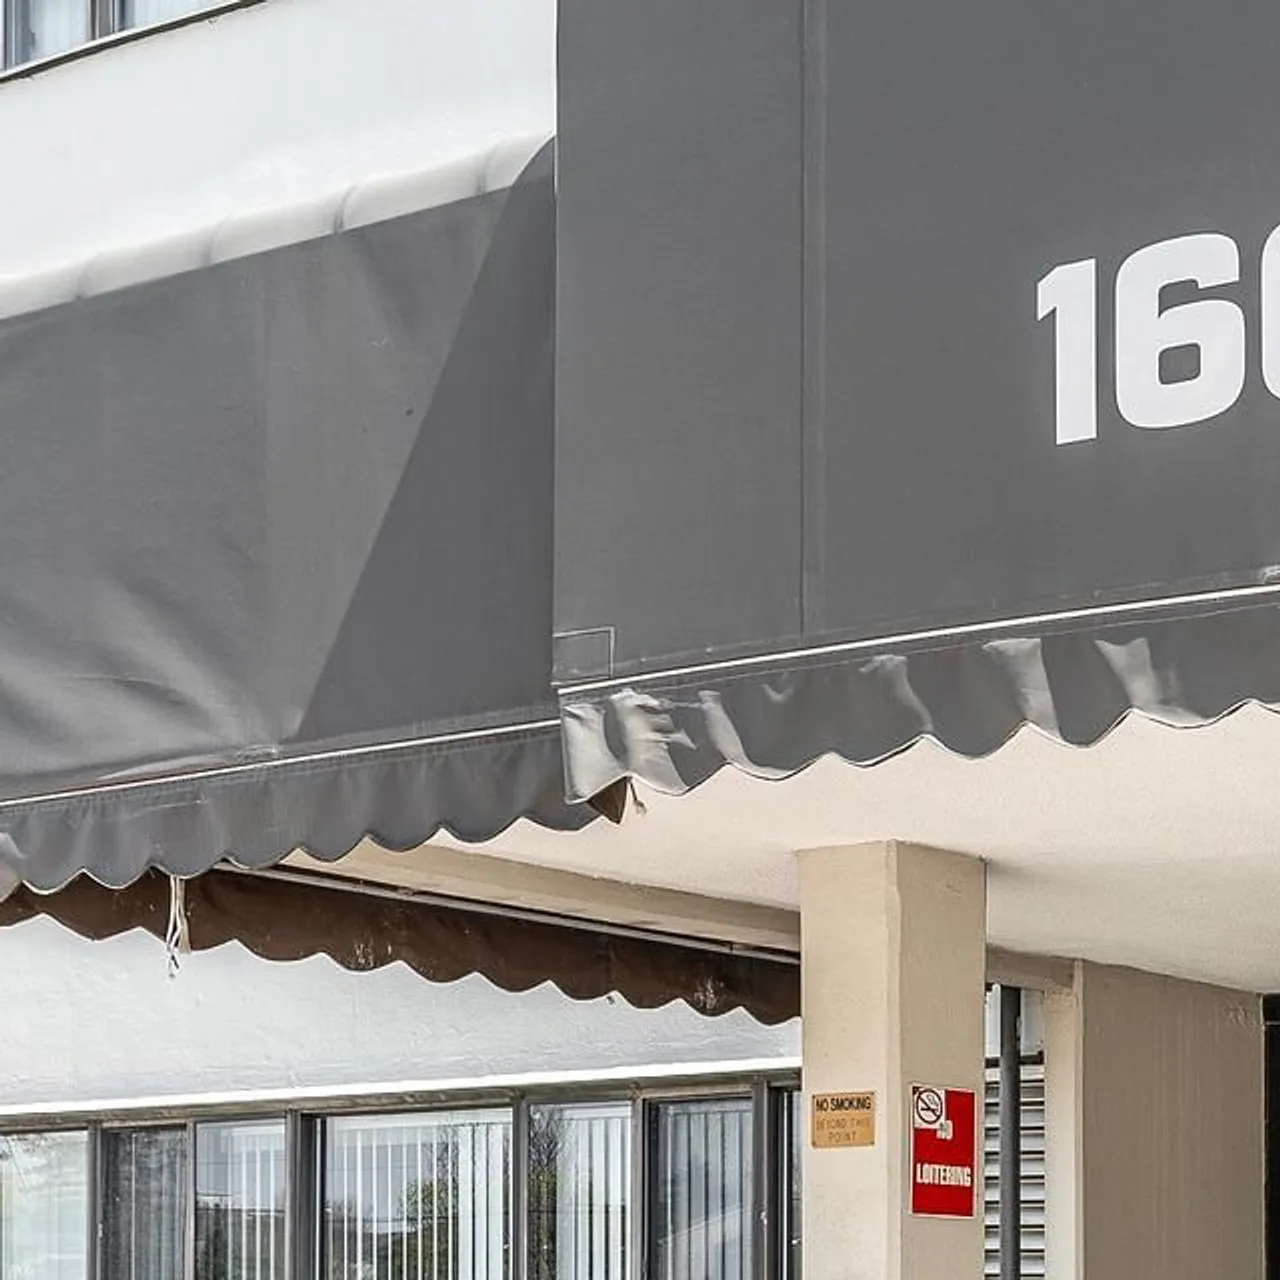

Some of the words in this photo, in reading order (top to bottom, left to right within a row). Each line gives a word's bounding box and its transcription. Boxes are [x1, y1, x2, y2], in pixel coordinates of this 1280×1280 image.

[816, 1099, 829, 1111] NO
[830, 1096, 871, 1111] SMOKING
[916, 1163, 971, 1187] LOITERING
